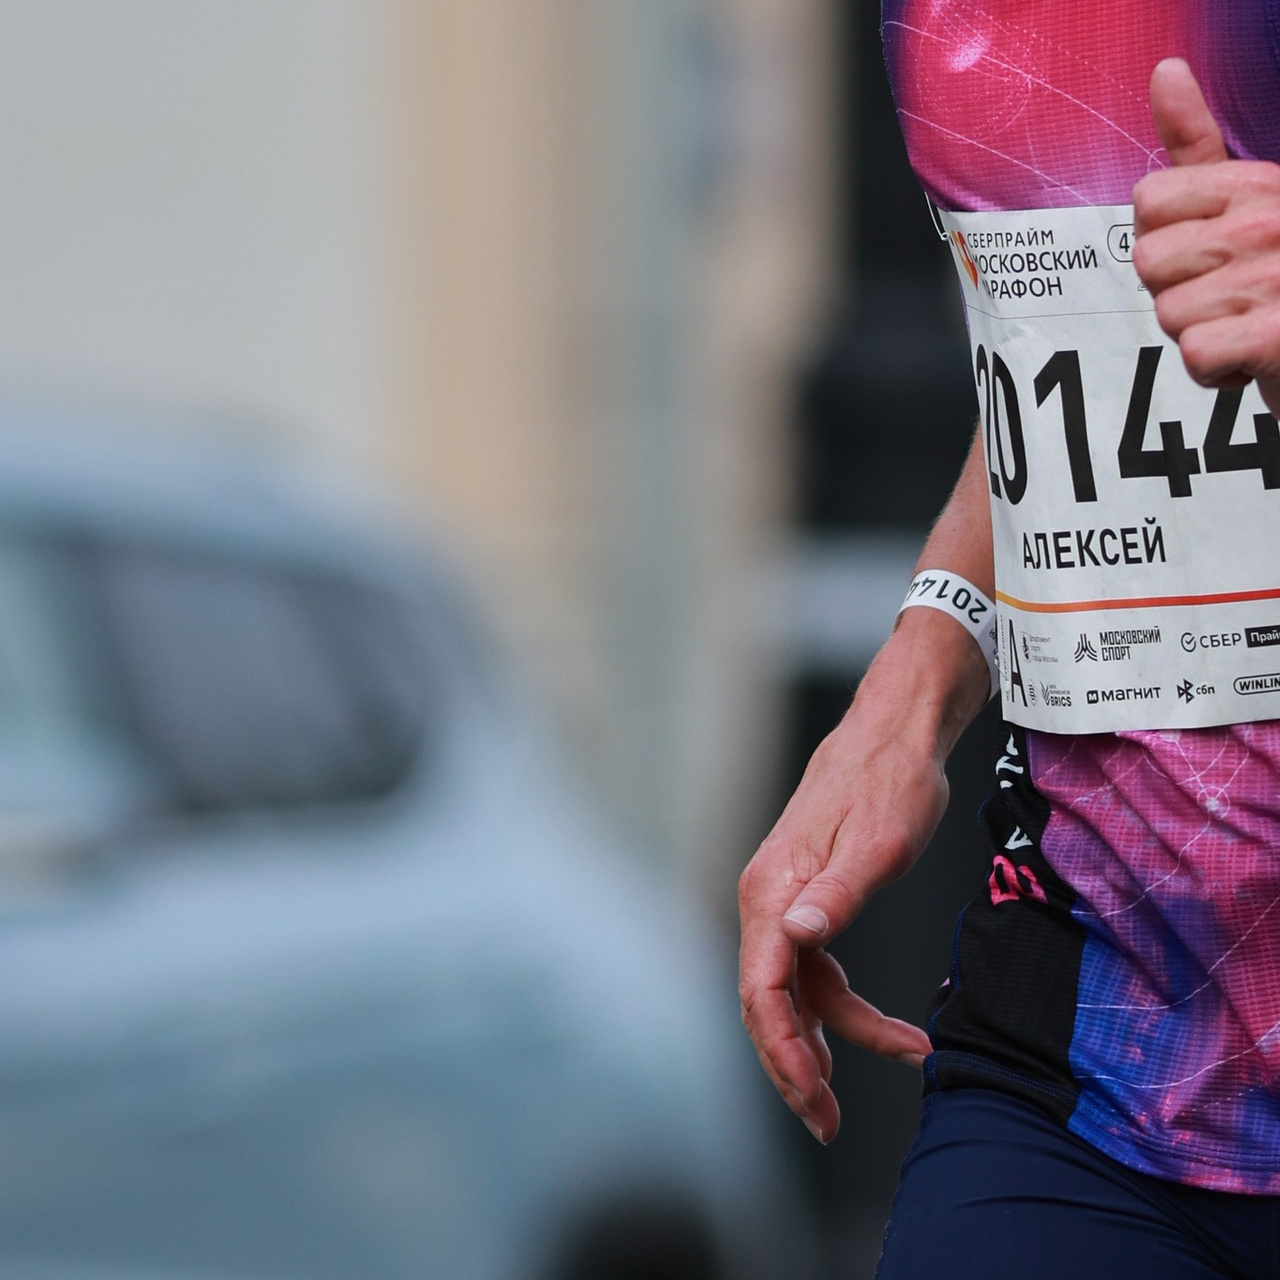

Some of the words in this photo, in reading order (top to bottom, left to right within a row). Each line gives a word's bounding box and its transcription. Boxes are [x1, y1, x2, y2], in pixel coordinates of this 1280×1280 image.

[967, 228, 1054, 249] СБЕРПРАЙМ
[1118, 232, 1136, 253] 4
[982, 276, 1063, 300] РАФОН
[1023, 517, 1166, 570] АЛЕКСЕЙ
[905, 577, 988, 624] 20144
[1099, 626, 1161, 646] МОСКОВСКИЙ
[1200, 633, 1241, 648] СБЕР
[1101, 646, 1131, 661] СПОРТ
[1050, 696, 1072, 707] BRICS
